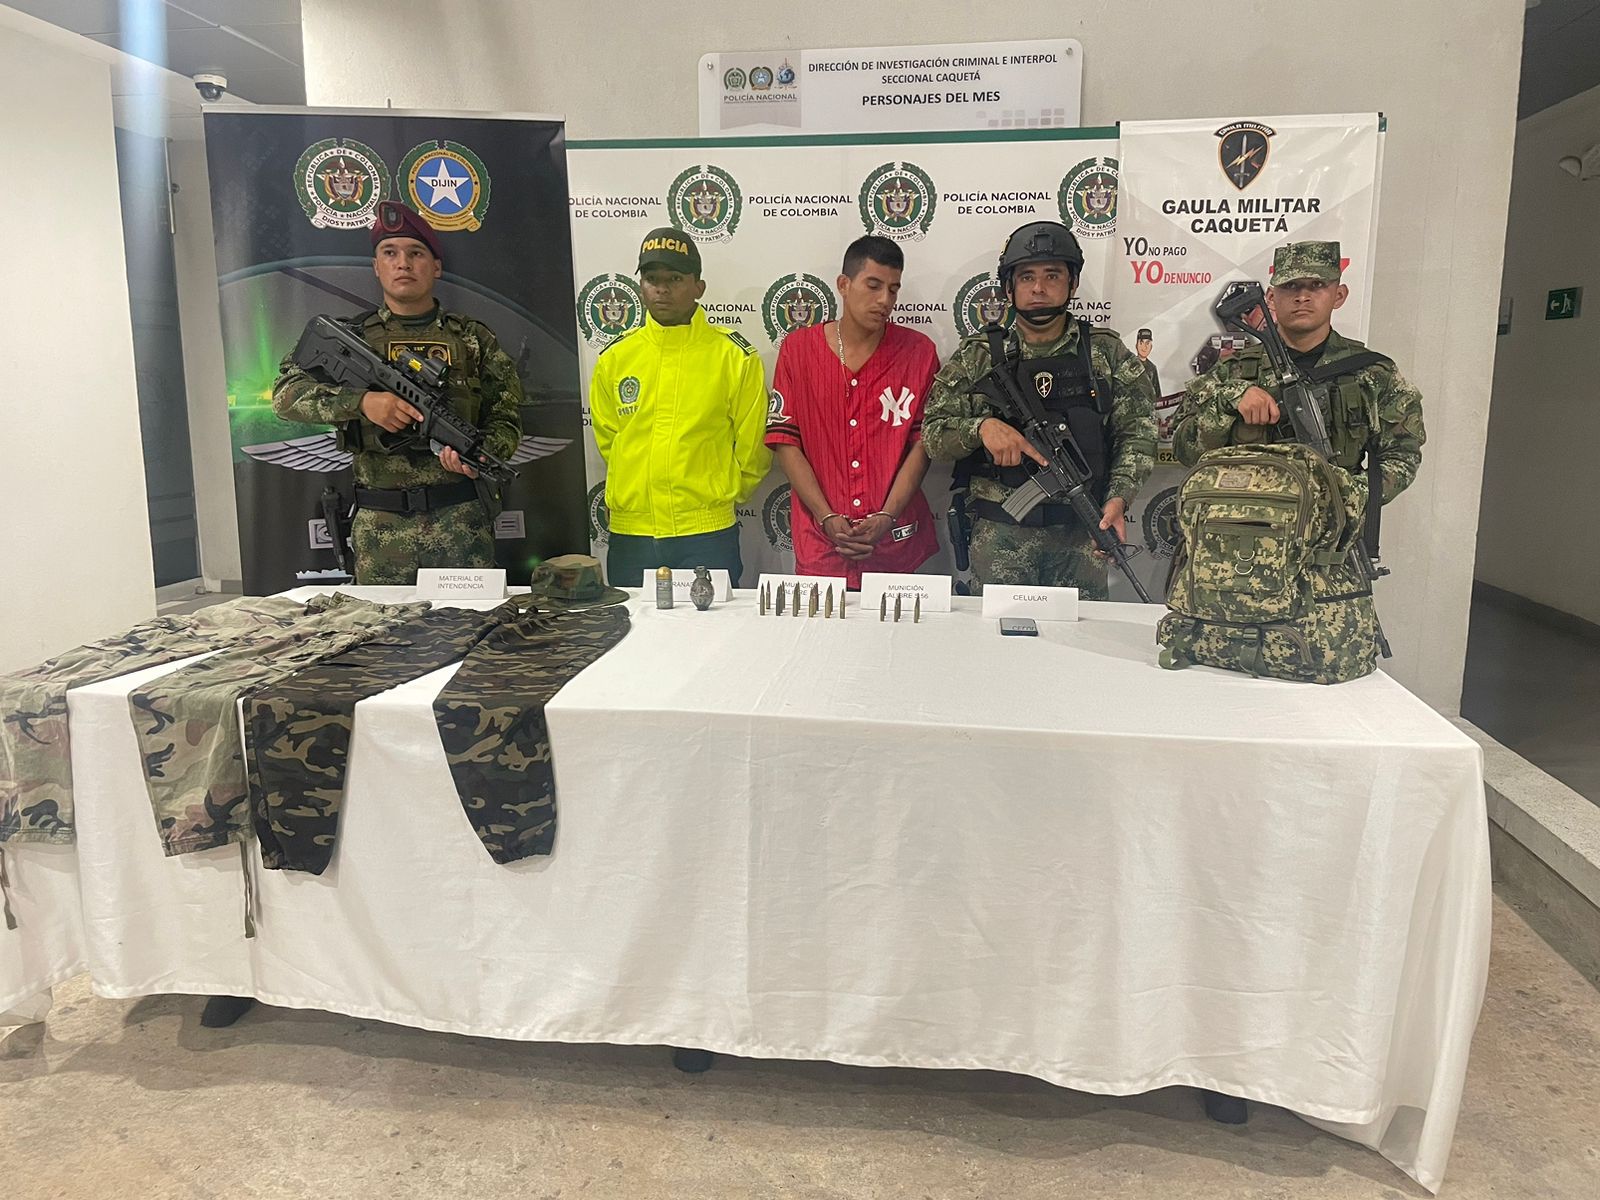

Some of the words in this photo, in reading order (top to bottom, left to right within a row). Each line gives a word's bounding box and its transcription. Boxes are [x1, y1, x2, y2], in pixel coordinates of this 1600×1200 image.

[808, 59, 859, 72] DIRECCIÓN
[861, 61, 874, 70] DE
[876, 56, 950, 70] INVESTIGACIÓN
[952, 57, 1000, 67] CRIMINAL
[1002, 56, 1008, 65] E
[1010, 54, 1058, 64] INTERPOL
[882, 74, 934, 84] SECCIONAL
[936, 70, 981, 83] CAQUETÁ
[723, 93, 755, 102] POLICÍA
[756, 93, 798, 101] NACIONAL
[862, 93, 942, 106] PERSONAJES
[945, 92, 970, 103] DEL
[972, 91, 1001, 102] MES
[307, 152, 330, 188] REPUBLICA
[354, 153, 380, 190] COLOMBIA
[431, 179, 457, 187] DIJIN
[715, 177, 733, 209] COLOMBIA
[908, 174, 928, 207] COLOMBIA
[943, 190, 988, 202] POLICÍA
[991, 191, 1052, 201] NACIONAL
[568, 195, 603, 206] OLICÍA
[605, 196, 662, 206] NACIONAL
[749, 193, 792, 204] POLICÍA
[794, 195, 853, 204] NACIONAL
[346, 197, 377, 218] NACIONAL
[763, 208, 778, 217] DE
[780, 207, 838, 217] COLOMBIA
[957, 205, 973, 215] DE
[975, 204, 1036, 214] COLOMBIA
[1162, 199, 1231, 215] GAULA
[1237, 198, 1321, 214] MILITAR
[575, 209, 589, 218] DE
[591, 209, 648, 218] COLOMBIA
[321, 215, 341, 226] DIOS
[346, 217, 371, 227] PATRIA
[1096, 218, 1117, 230] NACIO
[1191, 214, 1289, 234] CAQUETÁ
[642, 237, 689, 256] POLICIA
[1123, 237, 1149, 256] YO
[1148, 246, 1161, 256] NO
[1163, 246, 1187, 256] PAGO
[1130, 260, 1164, 284] YO
[1163, 272, 1212, 284] DENUNCIO
[707, 316, 743, 324] OMBIA
[886, 315, 933, 324] LOMBIA
[878, 386, 915, 426] NY
[1012, 594, 1048, 602] CELULAR
